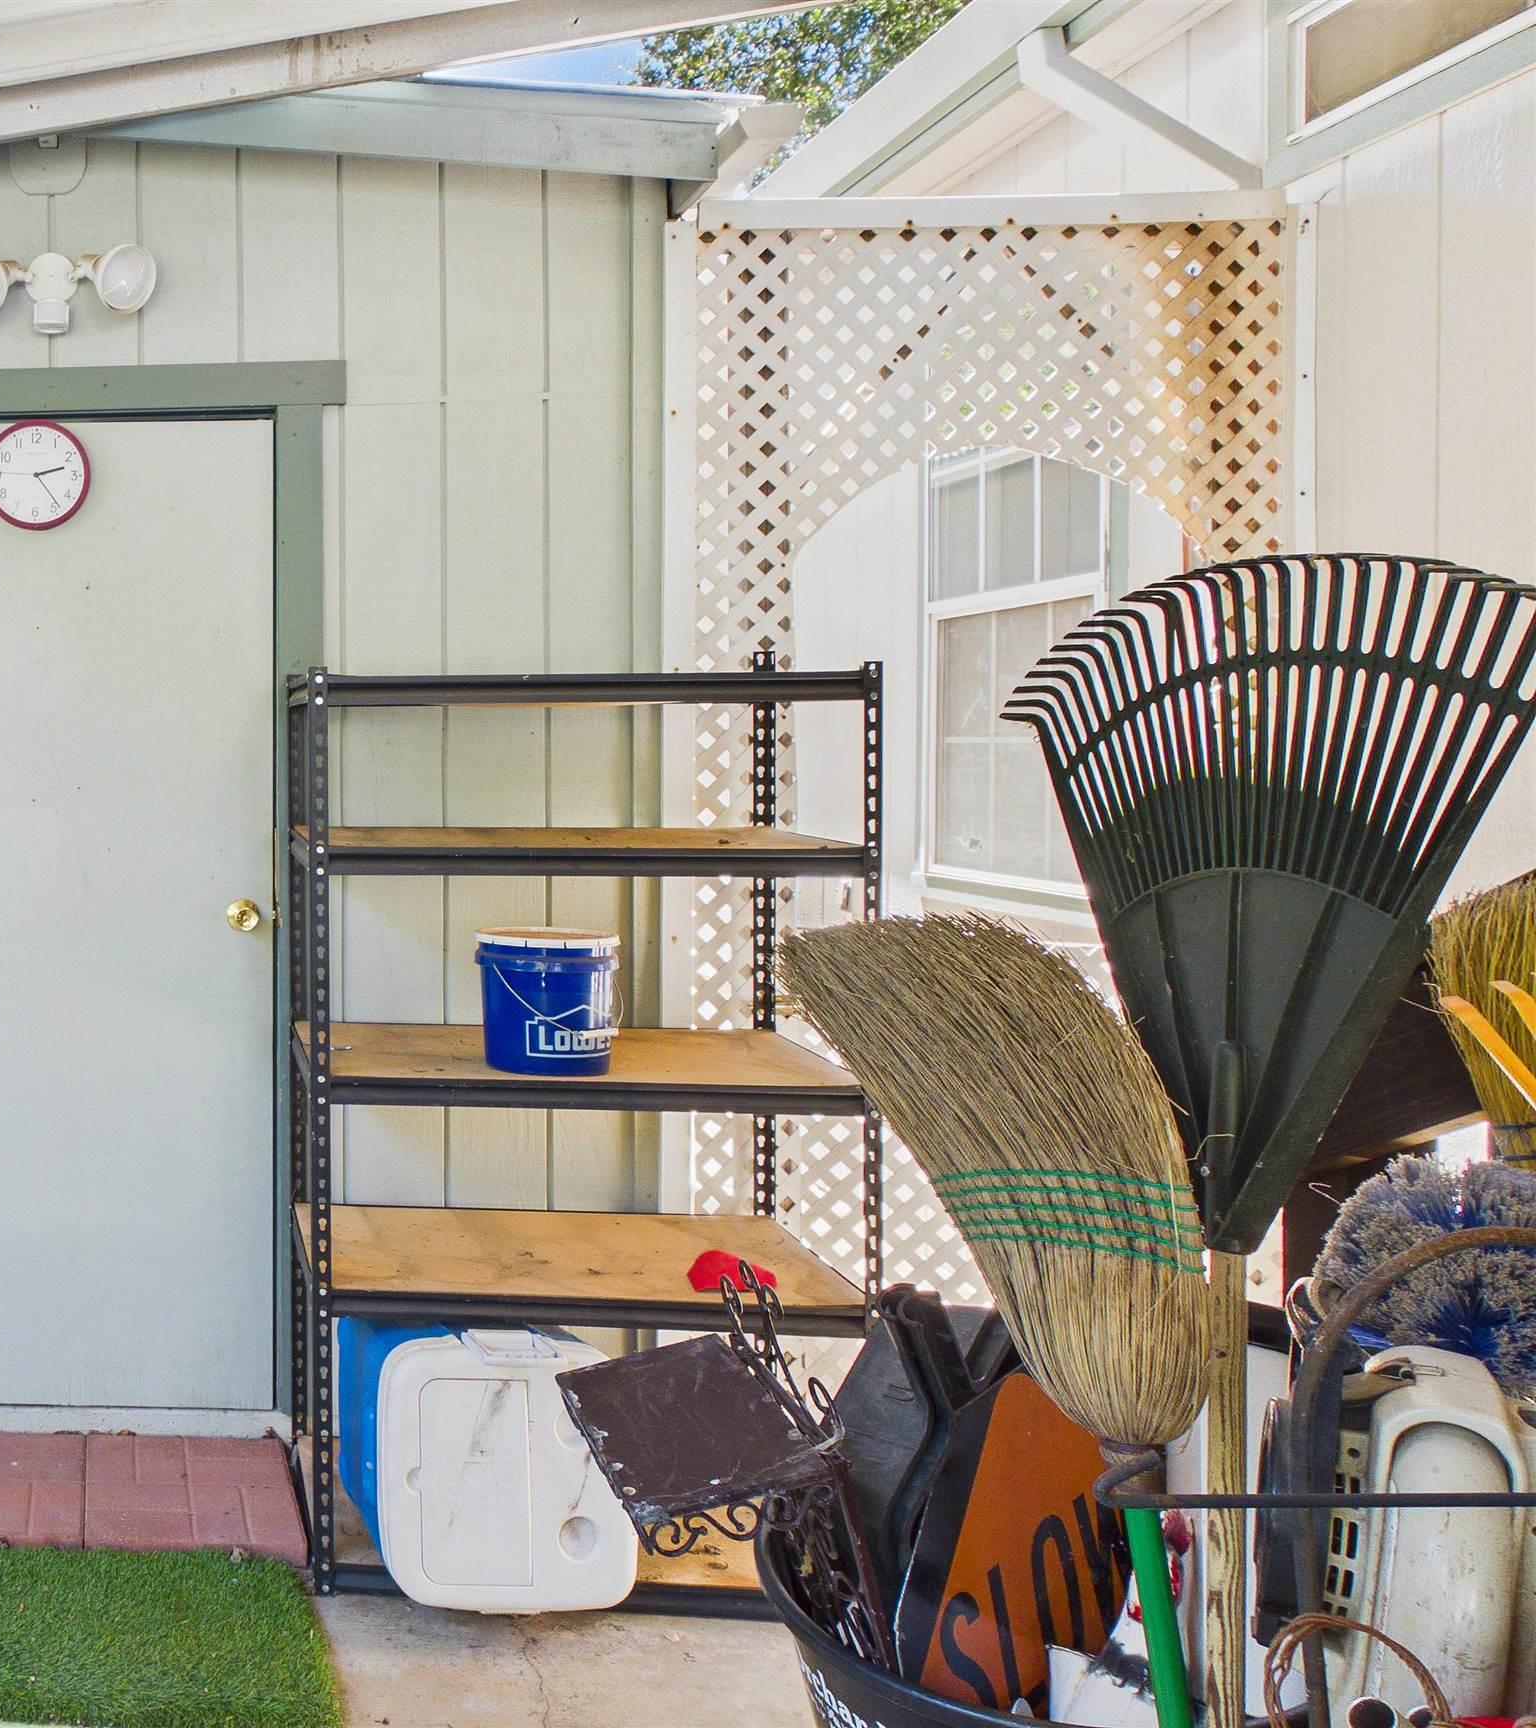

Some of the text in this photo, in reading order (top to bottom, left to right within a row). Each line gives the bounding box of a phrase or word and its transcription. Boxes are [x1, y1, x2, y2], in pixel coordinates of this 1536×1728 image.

[15, 438, 22, 449] 11
[31, 432, 42, 444] 12
[0, 452, 11, 463] 10
[65, 451, 73, 462] 2
[71, 470, 78, 481] 3
[0, 488, 7, 499] 8
[64, 489, 71, 499] 4
[31, 506, 39, 517] 6
[50, 501, 58, 513] 5
